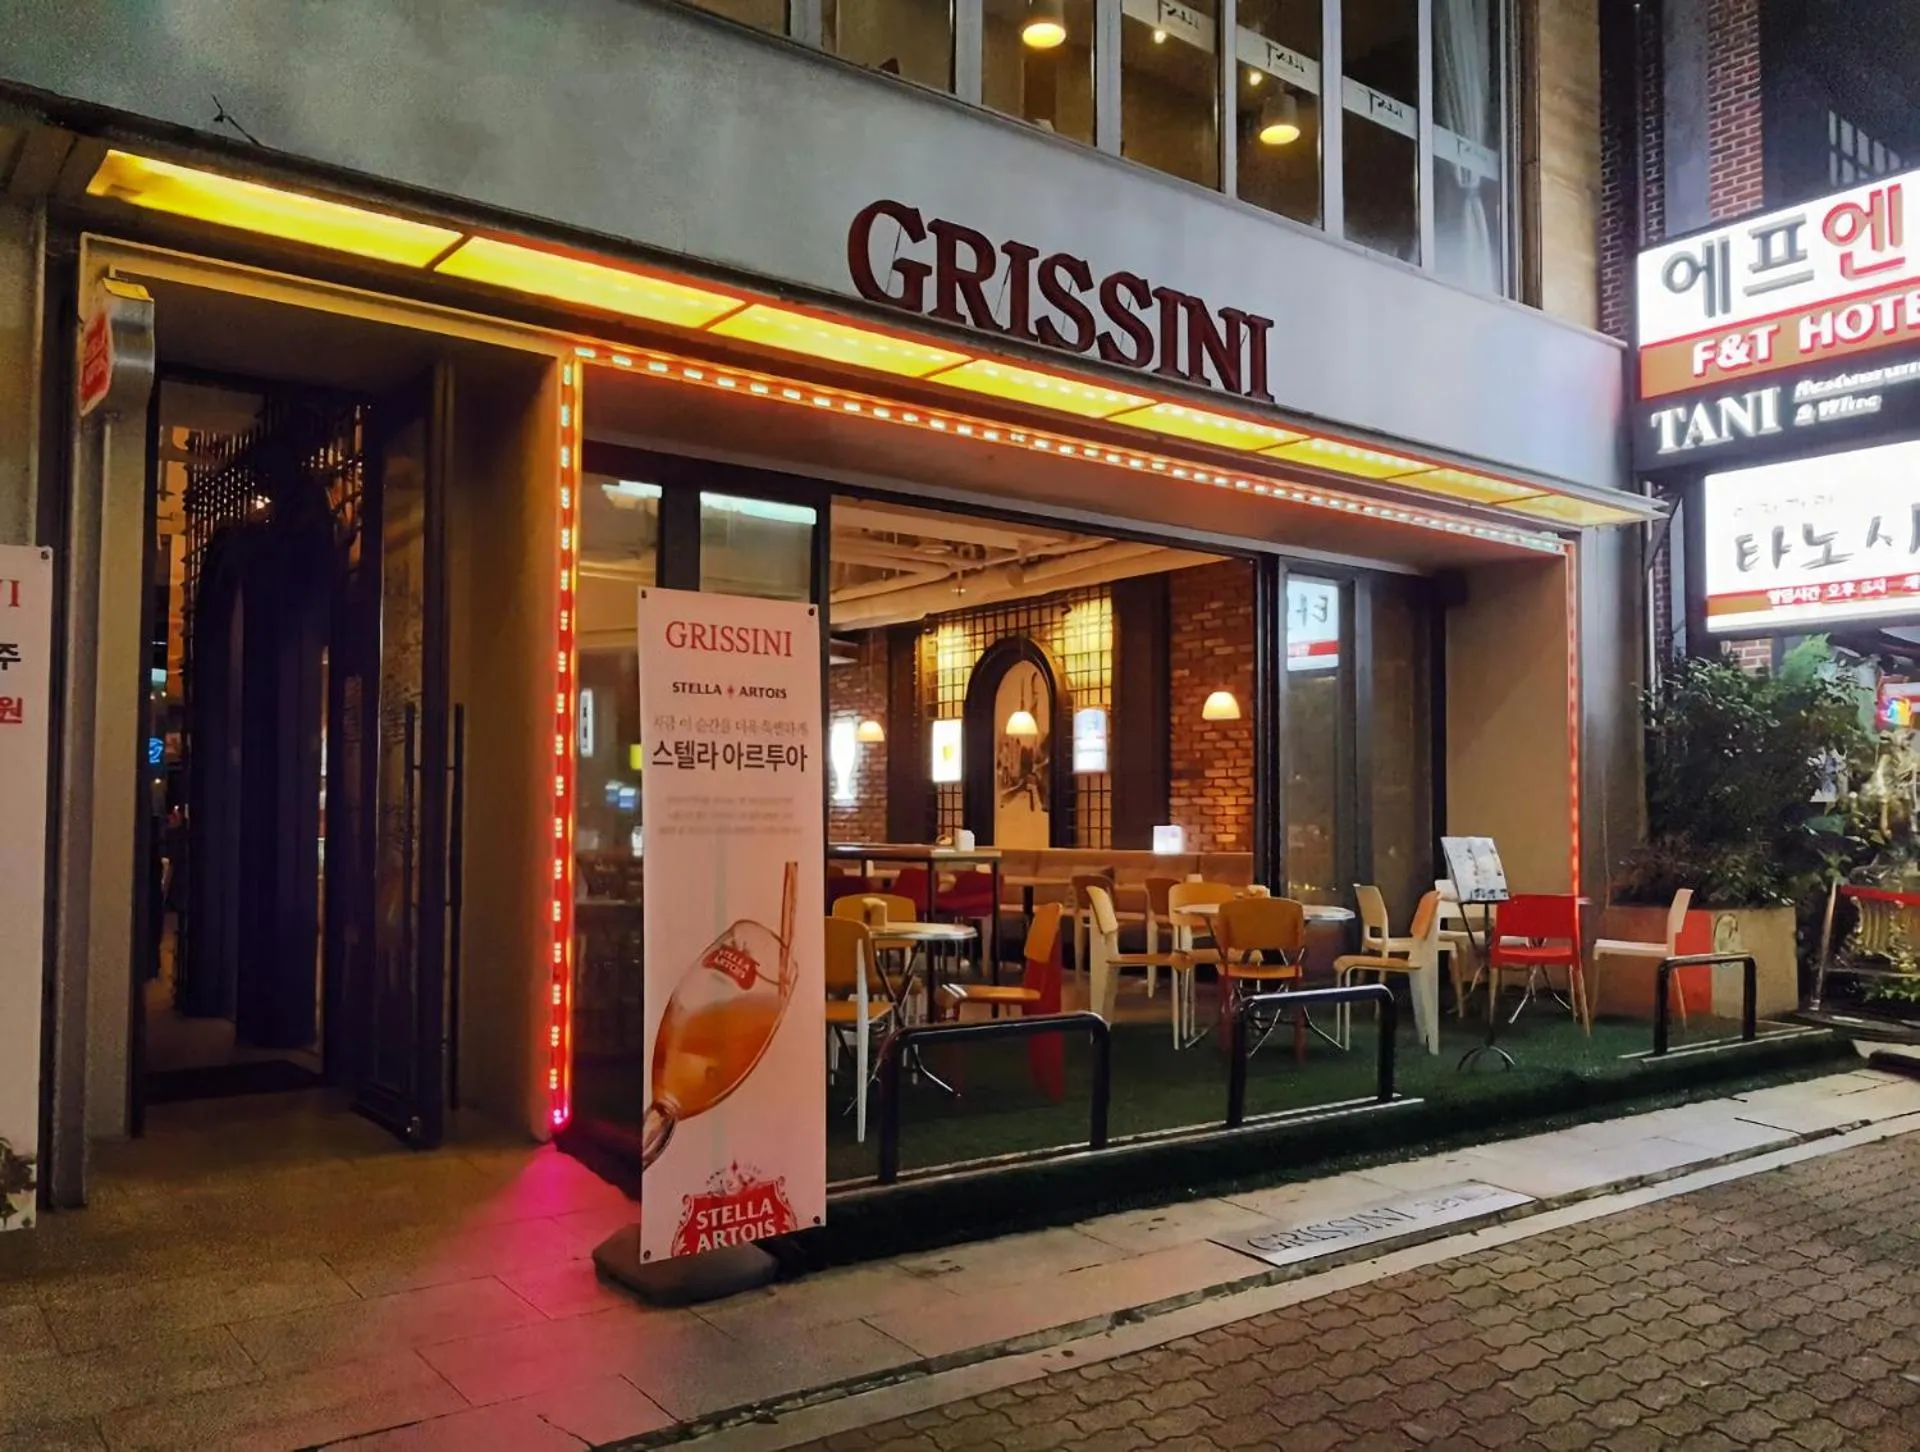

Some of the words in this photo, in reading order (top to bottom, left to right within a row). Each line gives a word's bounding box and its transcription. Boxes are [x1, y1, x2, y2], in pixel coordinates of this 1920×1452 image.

[847, 200, 1275, 403] GRISSINI
[1693, 324, 1780, 377] F&T
[1651, 386, 1783, 454] TANI
[665, 620, 793, 657] GRISSINI
[672, 681, 723, 696] STELLA
[738, 685, 788, 699] ARTOIS
[652, 740, 720, 771] 스텔라
[722, 741, 809, 773] 아르투아
[696, 1198, 774, 1230] STELLA
[697, 1218, 777, 1254] ARTOIS
